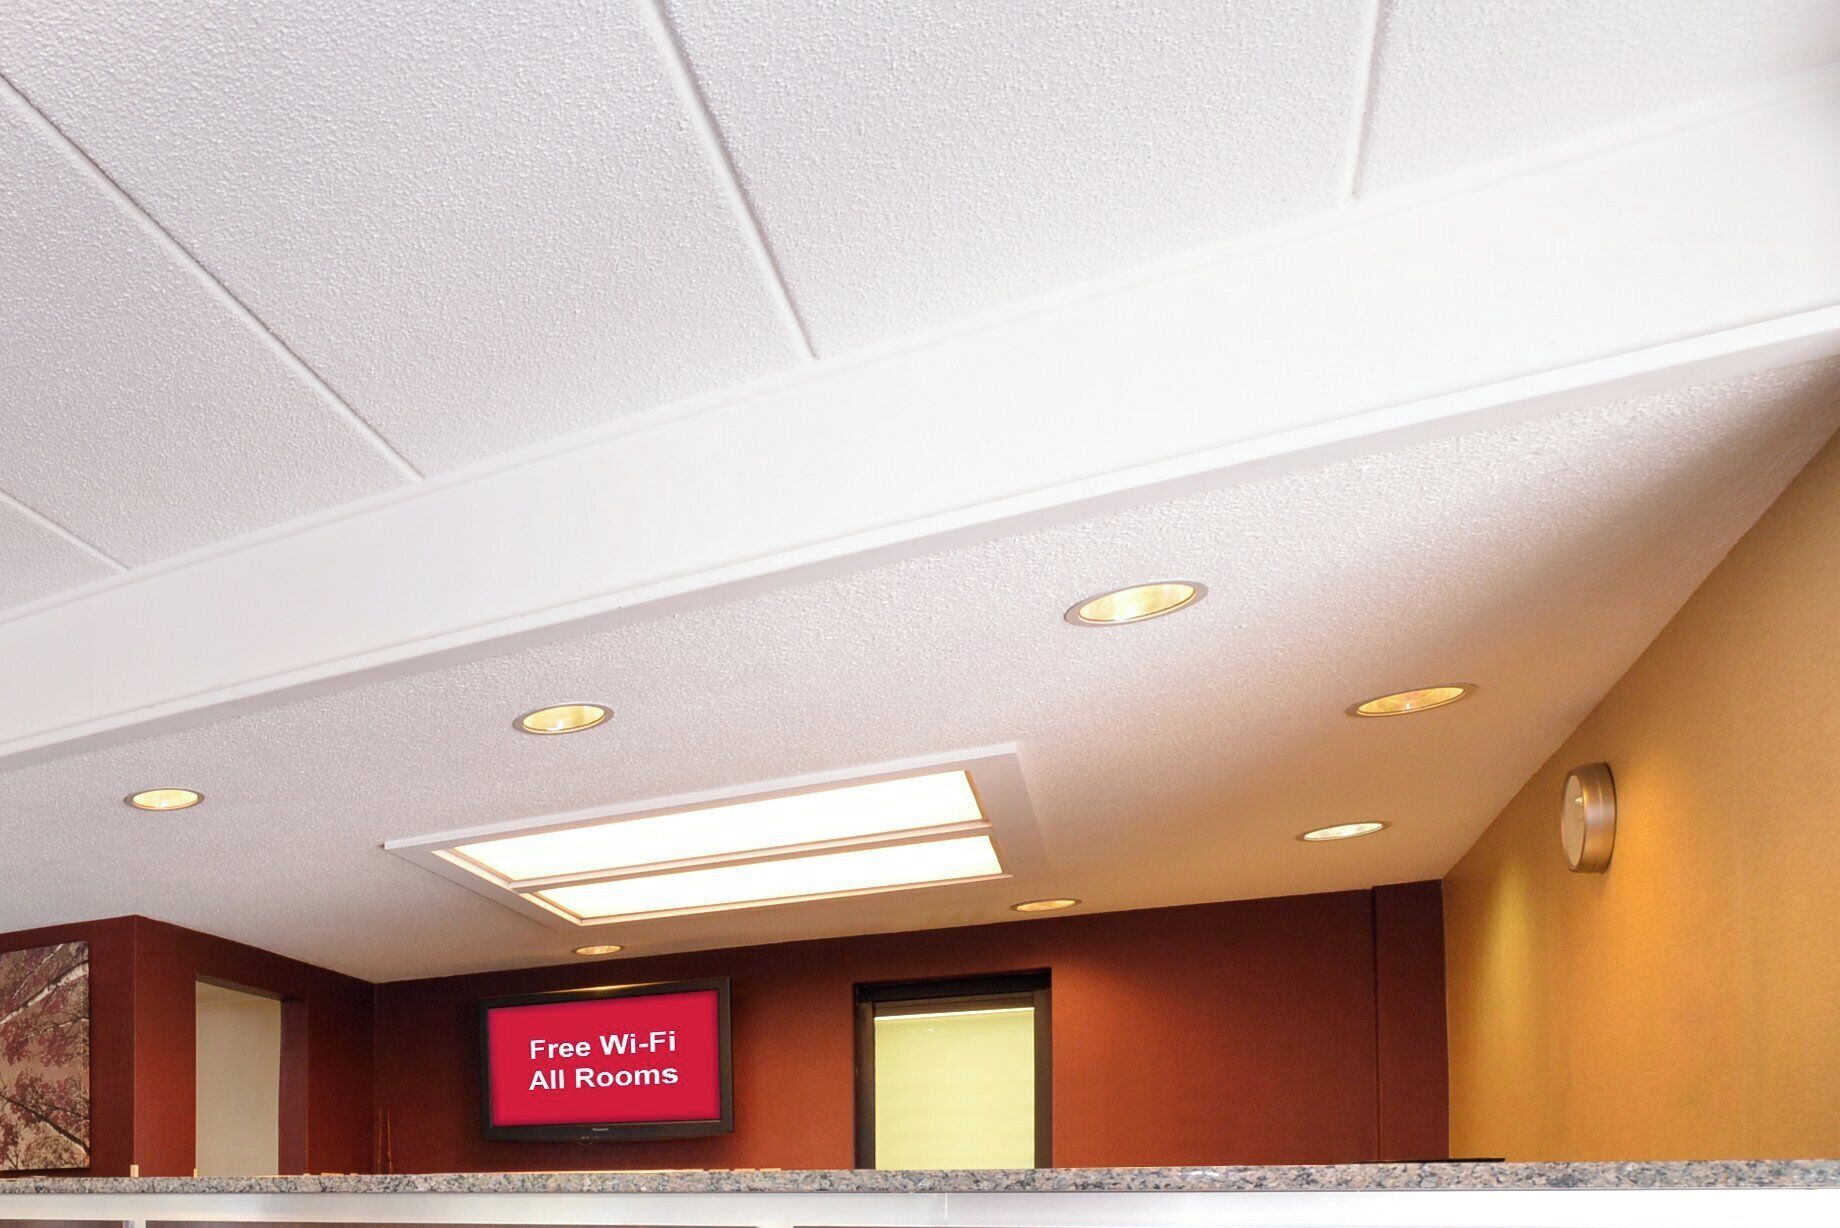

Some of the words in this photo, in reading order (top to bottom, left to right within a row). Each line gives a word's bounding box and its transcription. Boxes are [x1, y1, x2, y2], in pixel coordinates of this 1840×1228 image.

[530, 1039, 591, 1060] Free
[599, 1030, 676, 1056] Wi-Fi
[528, 1069, 565, 1091] All
[575, 1067, 679, 1089] Rooms
